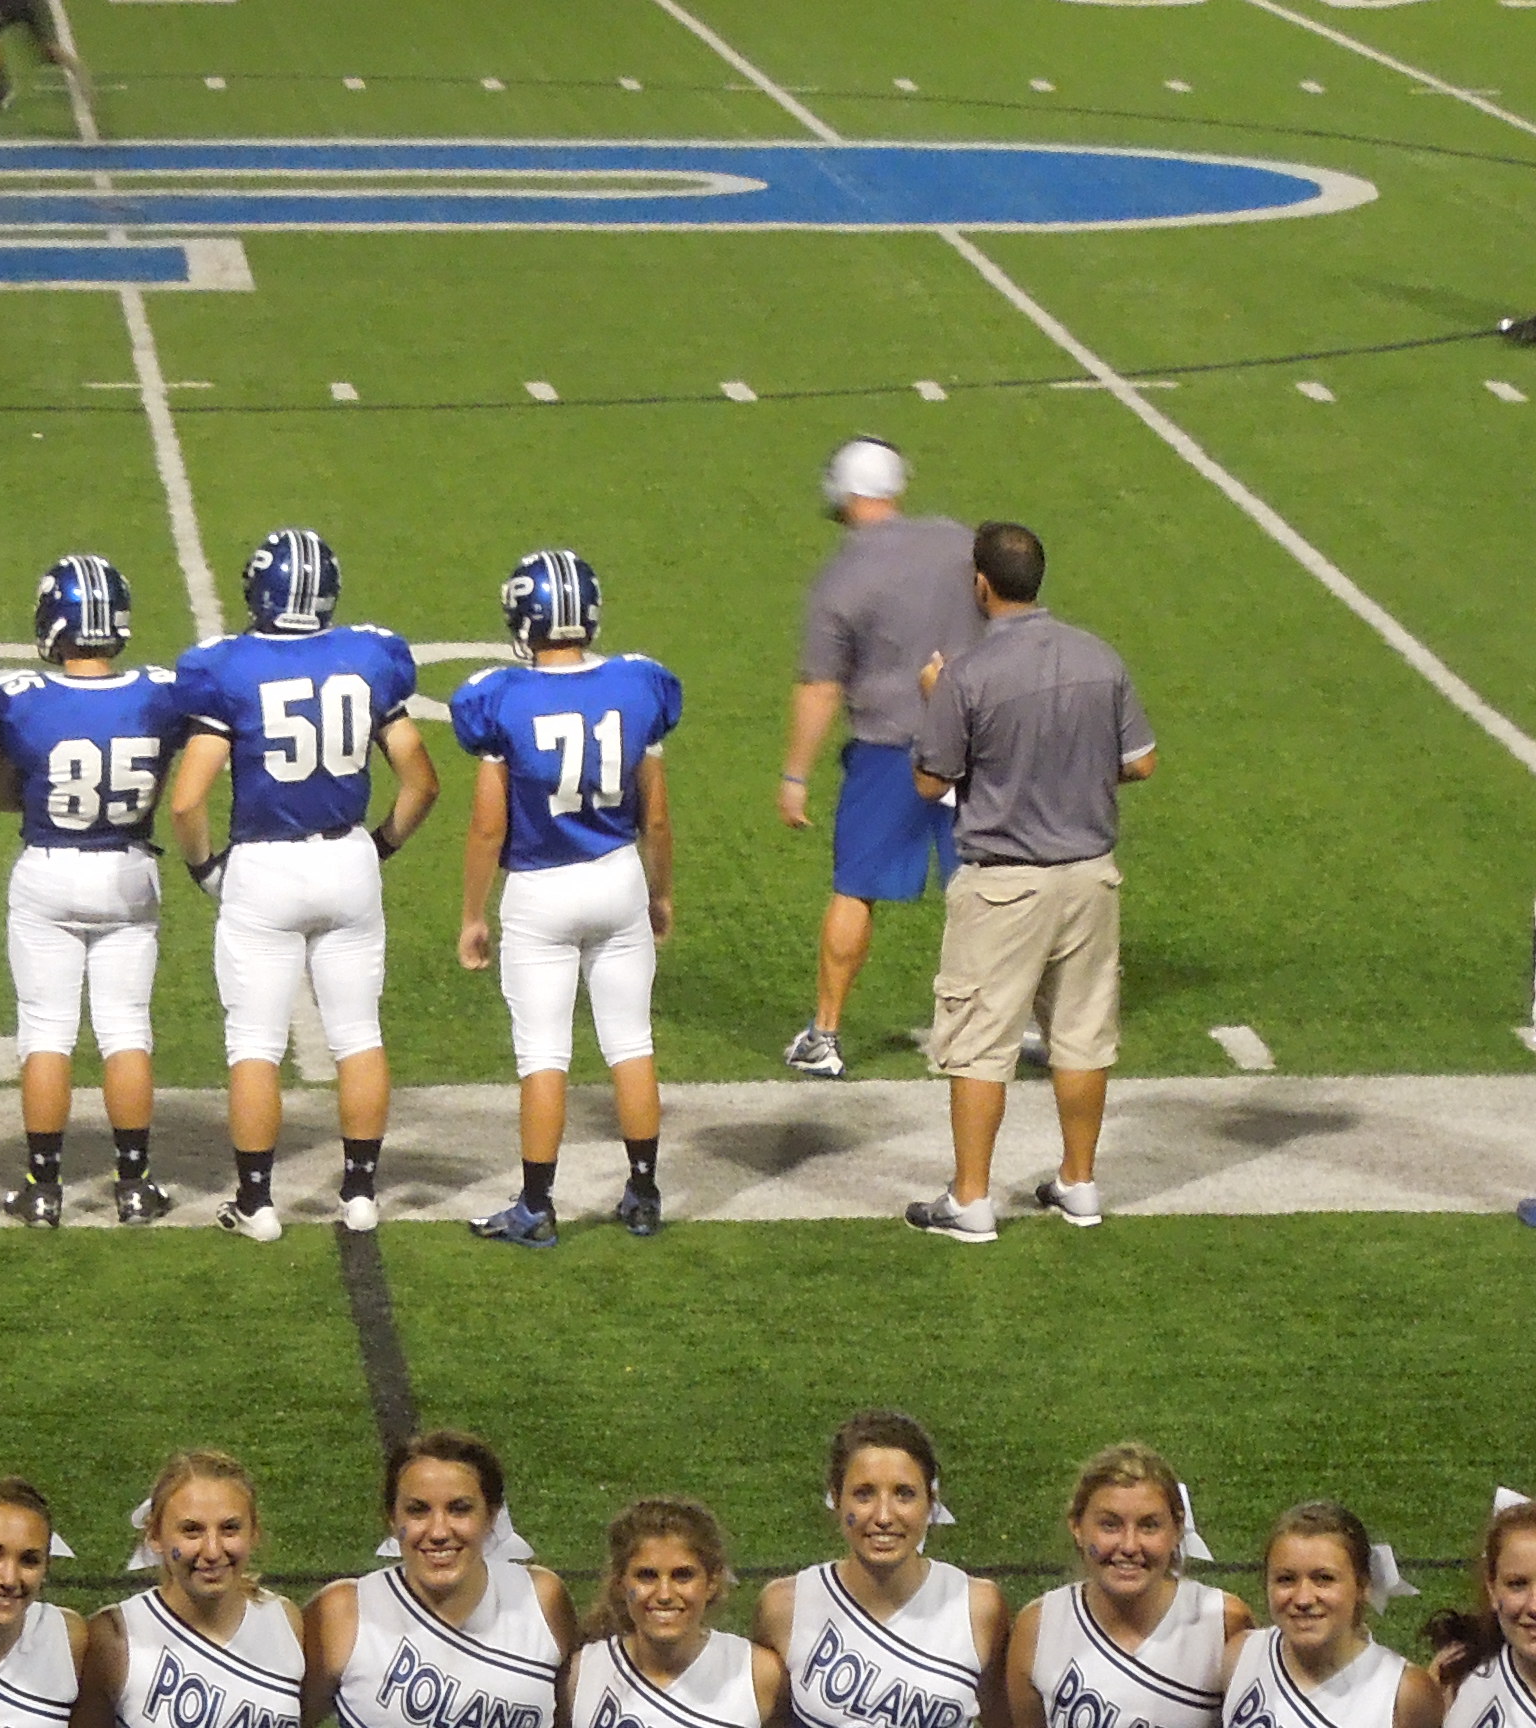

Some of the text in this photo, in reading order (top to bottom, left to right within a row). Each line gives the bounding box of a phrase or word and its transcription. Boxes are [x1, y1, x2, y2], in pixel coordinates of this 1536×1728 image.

[259, 674, 372, 783] 50
[533, 710, 622, 817] 71
[48, 737, 160, 830] 85
